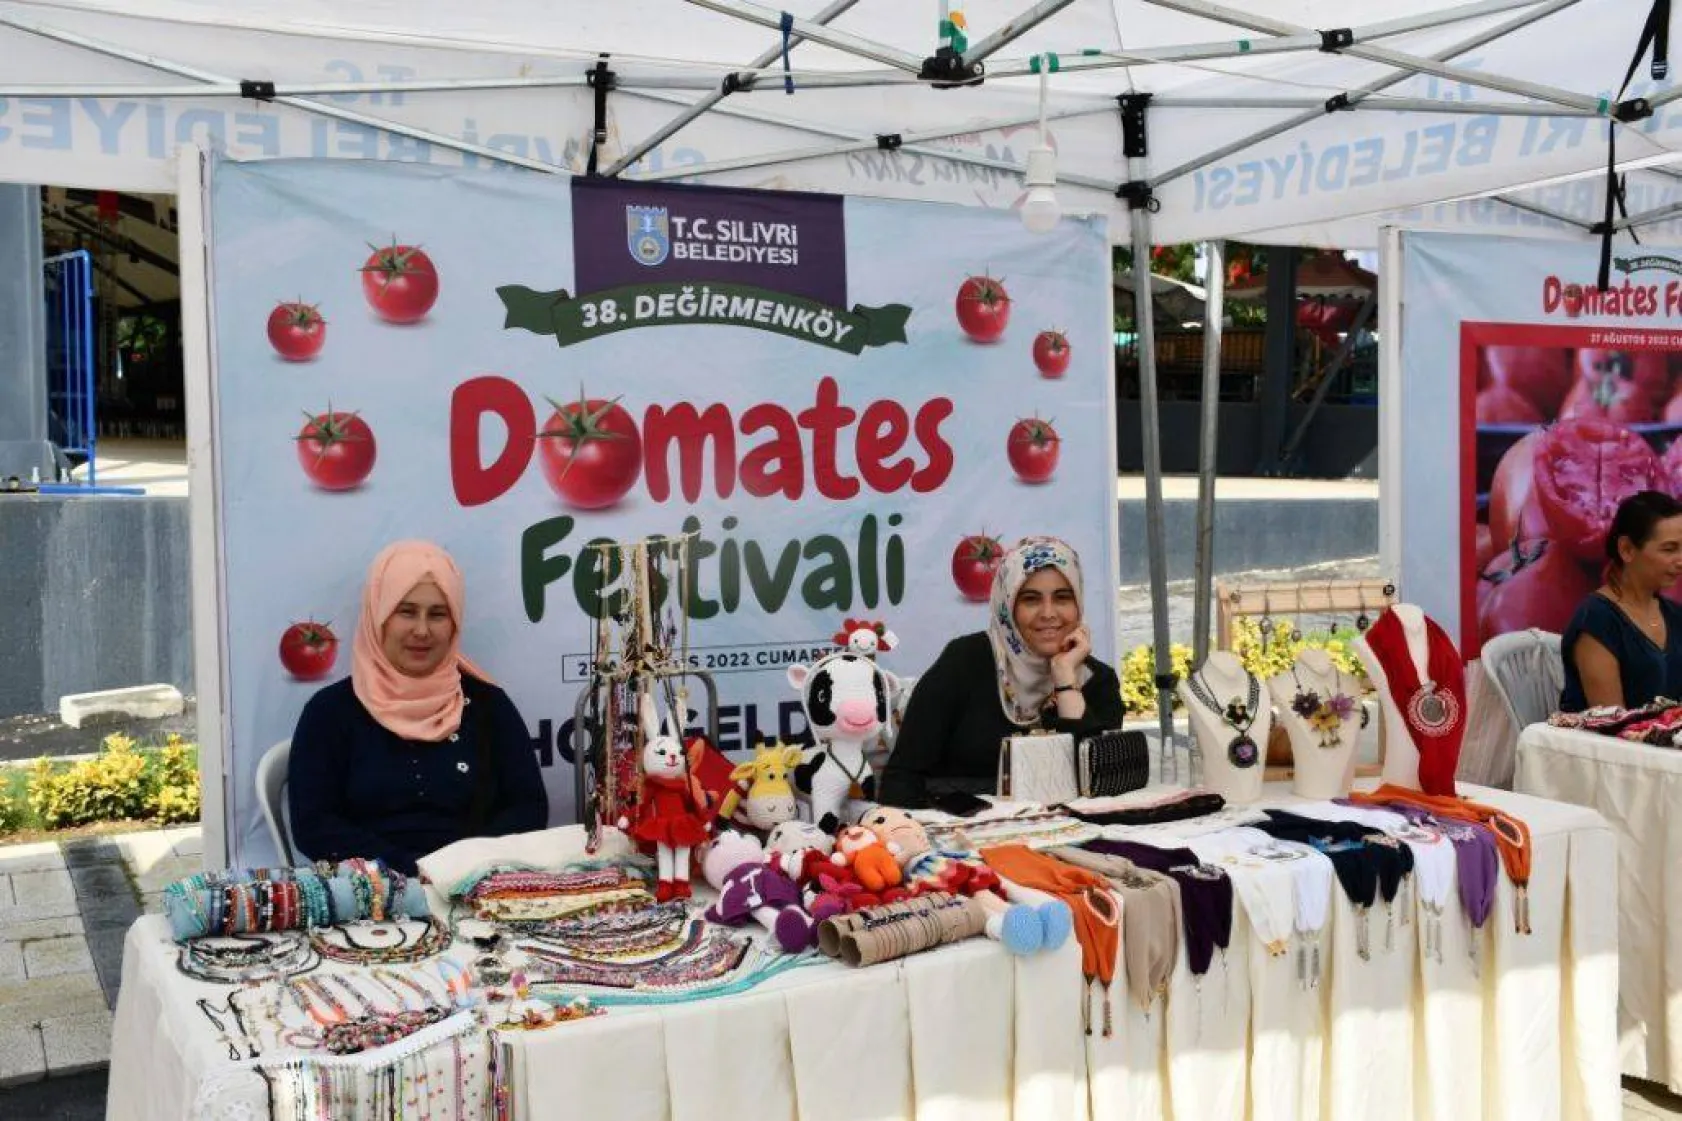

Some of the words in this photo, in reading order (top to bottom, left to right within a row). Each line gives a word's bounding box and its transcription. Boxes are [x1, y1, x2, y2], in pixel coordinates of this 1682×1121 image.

[671, 216, 713, 240] T.C.
[580, 303, 627, 328] 38.
[635, 286, 853, 344] DEĞİRMENKÖY
[706, 651, 750, 668] 2022
